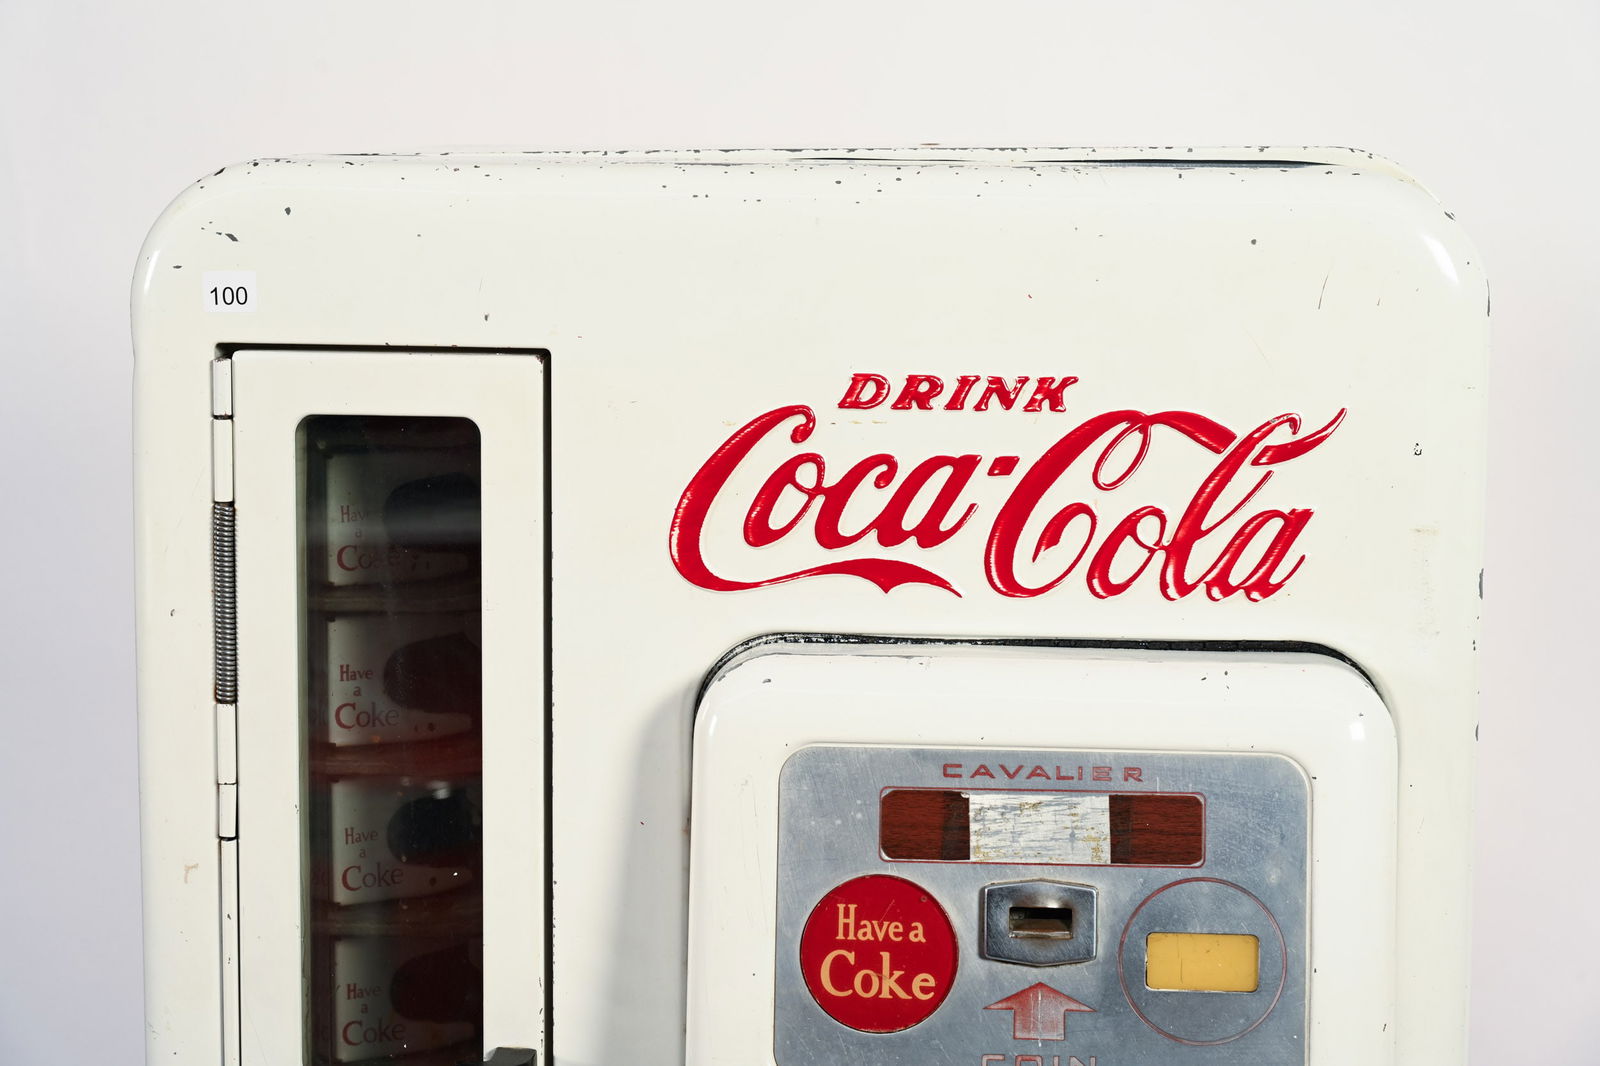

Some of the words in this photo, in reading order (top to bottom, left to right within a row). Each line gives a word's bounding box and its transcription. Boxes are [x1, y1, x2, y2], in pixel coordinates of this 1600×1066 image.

[210, 286, 248, 305] 100
[837, 373, 1080, 412] DRINK
[668, 405, 1347, 602] Coca-Cola
[340, 664, 374, 682] Have
[353, 686, 362, 697] a
[335, 702, 400, 730] Coke
[942, 763, 1144, 783] CAVALIER
[345, 827, 379, 845] Have
[359, 849, 367, 858] a
[341, 862, 404, 891] Coke
[835, 903, 904, 942] Have
[908, 921, 927, 943] a
[820, 949, 937, 1000] Coke
[346, 983, 383, 1000] Have
[361, 1003, 369, 1014] a
[342, 1017, 407, 1046] Coke
